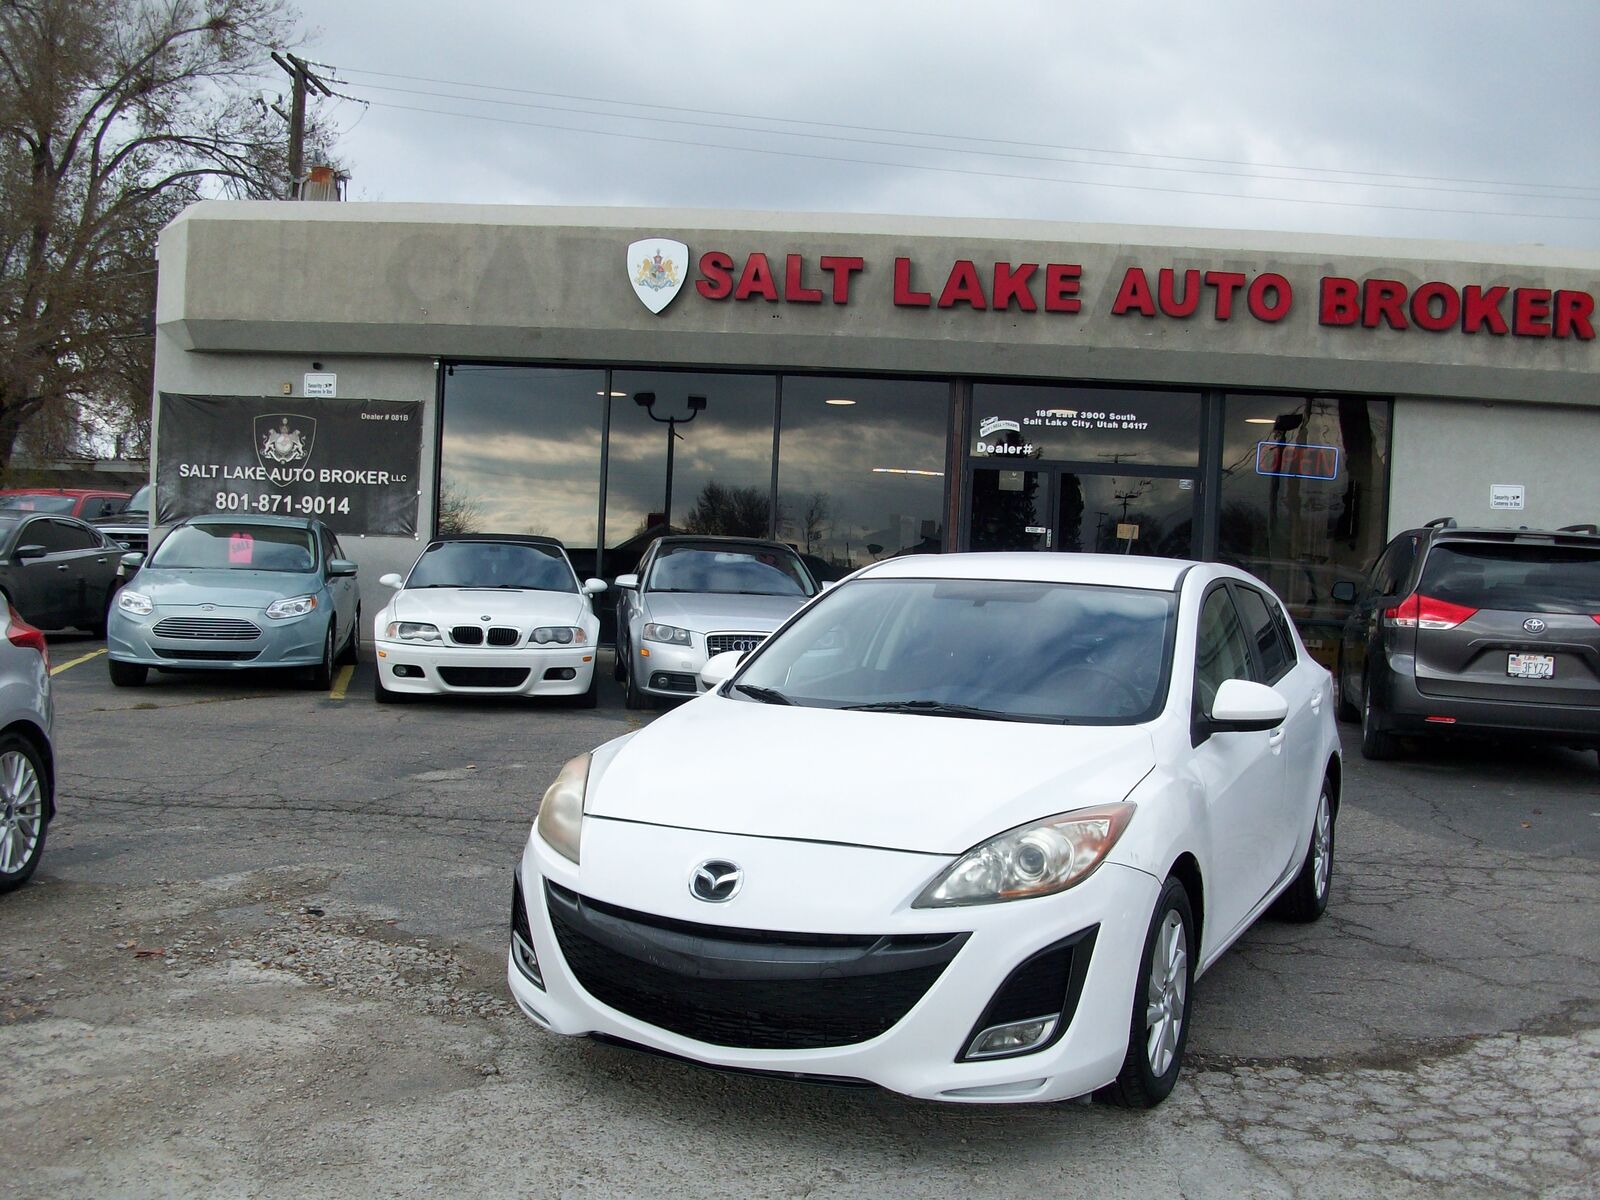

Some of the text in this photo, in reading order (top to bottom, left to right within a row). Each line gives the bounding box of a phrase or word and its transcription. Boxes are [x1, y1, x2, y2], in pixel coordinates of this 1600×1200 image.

[695, 251, 864, 304] SALT
[893, 257, 1082, 313] LAKE
[1111, 267, 1293, 323] AUTO
[1318, 276, 1596, 340] BROKER
[361, 412, 384, 421] Dealer
[1023, 417, 1148, 430] Salt Lake City, Utah 84117
[1080, 411, 1106, 420] 3900
[1108, 412, 1136, 421] South
[1260, 445, 1335, 477] OPEN
[179, 463, 407, 485] SALT LAKE AUTO BROKER LLC
[215, 492, 350, 515] 801-871-9014
